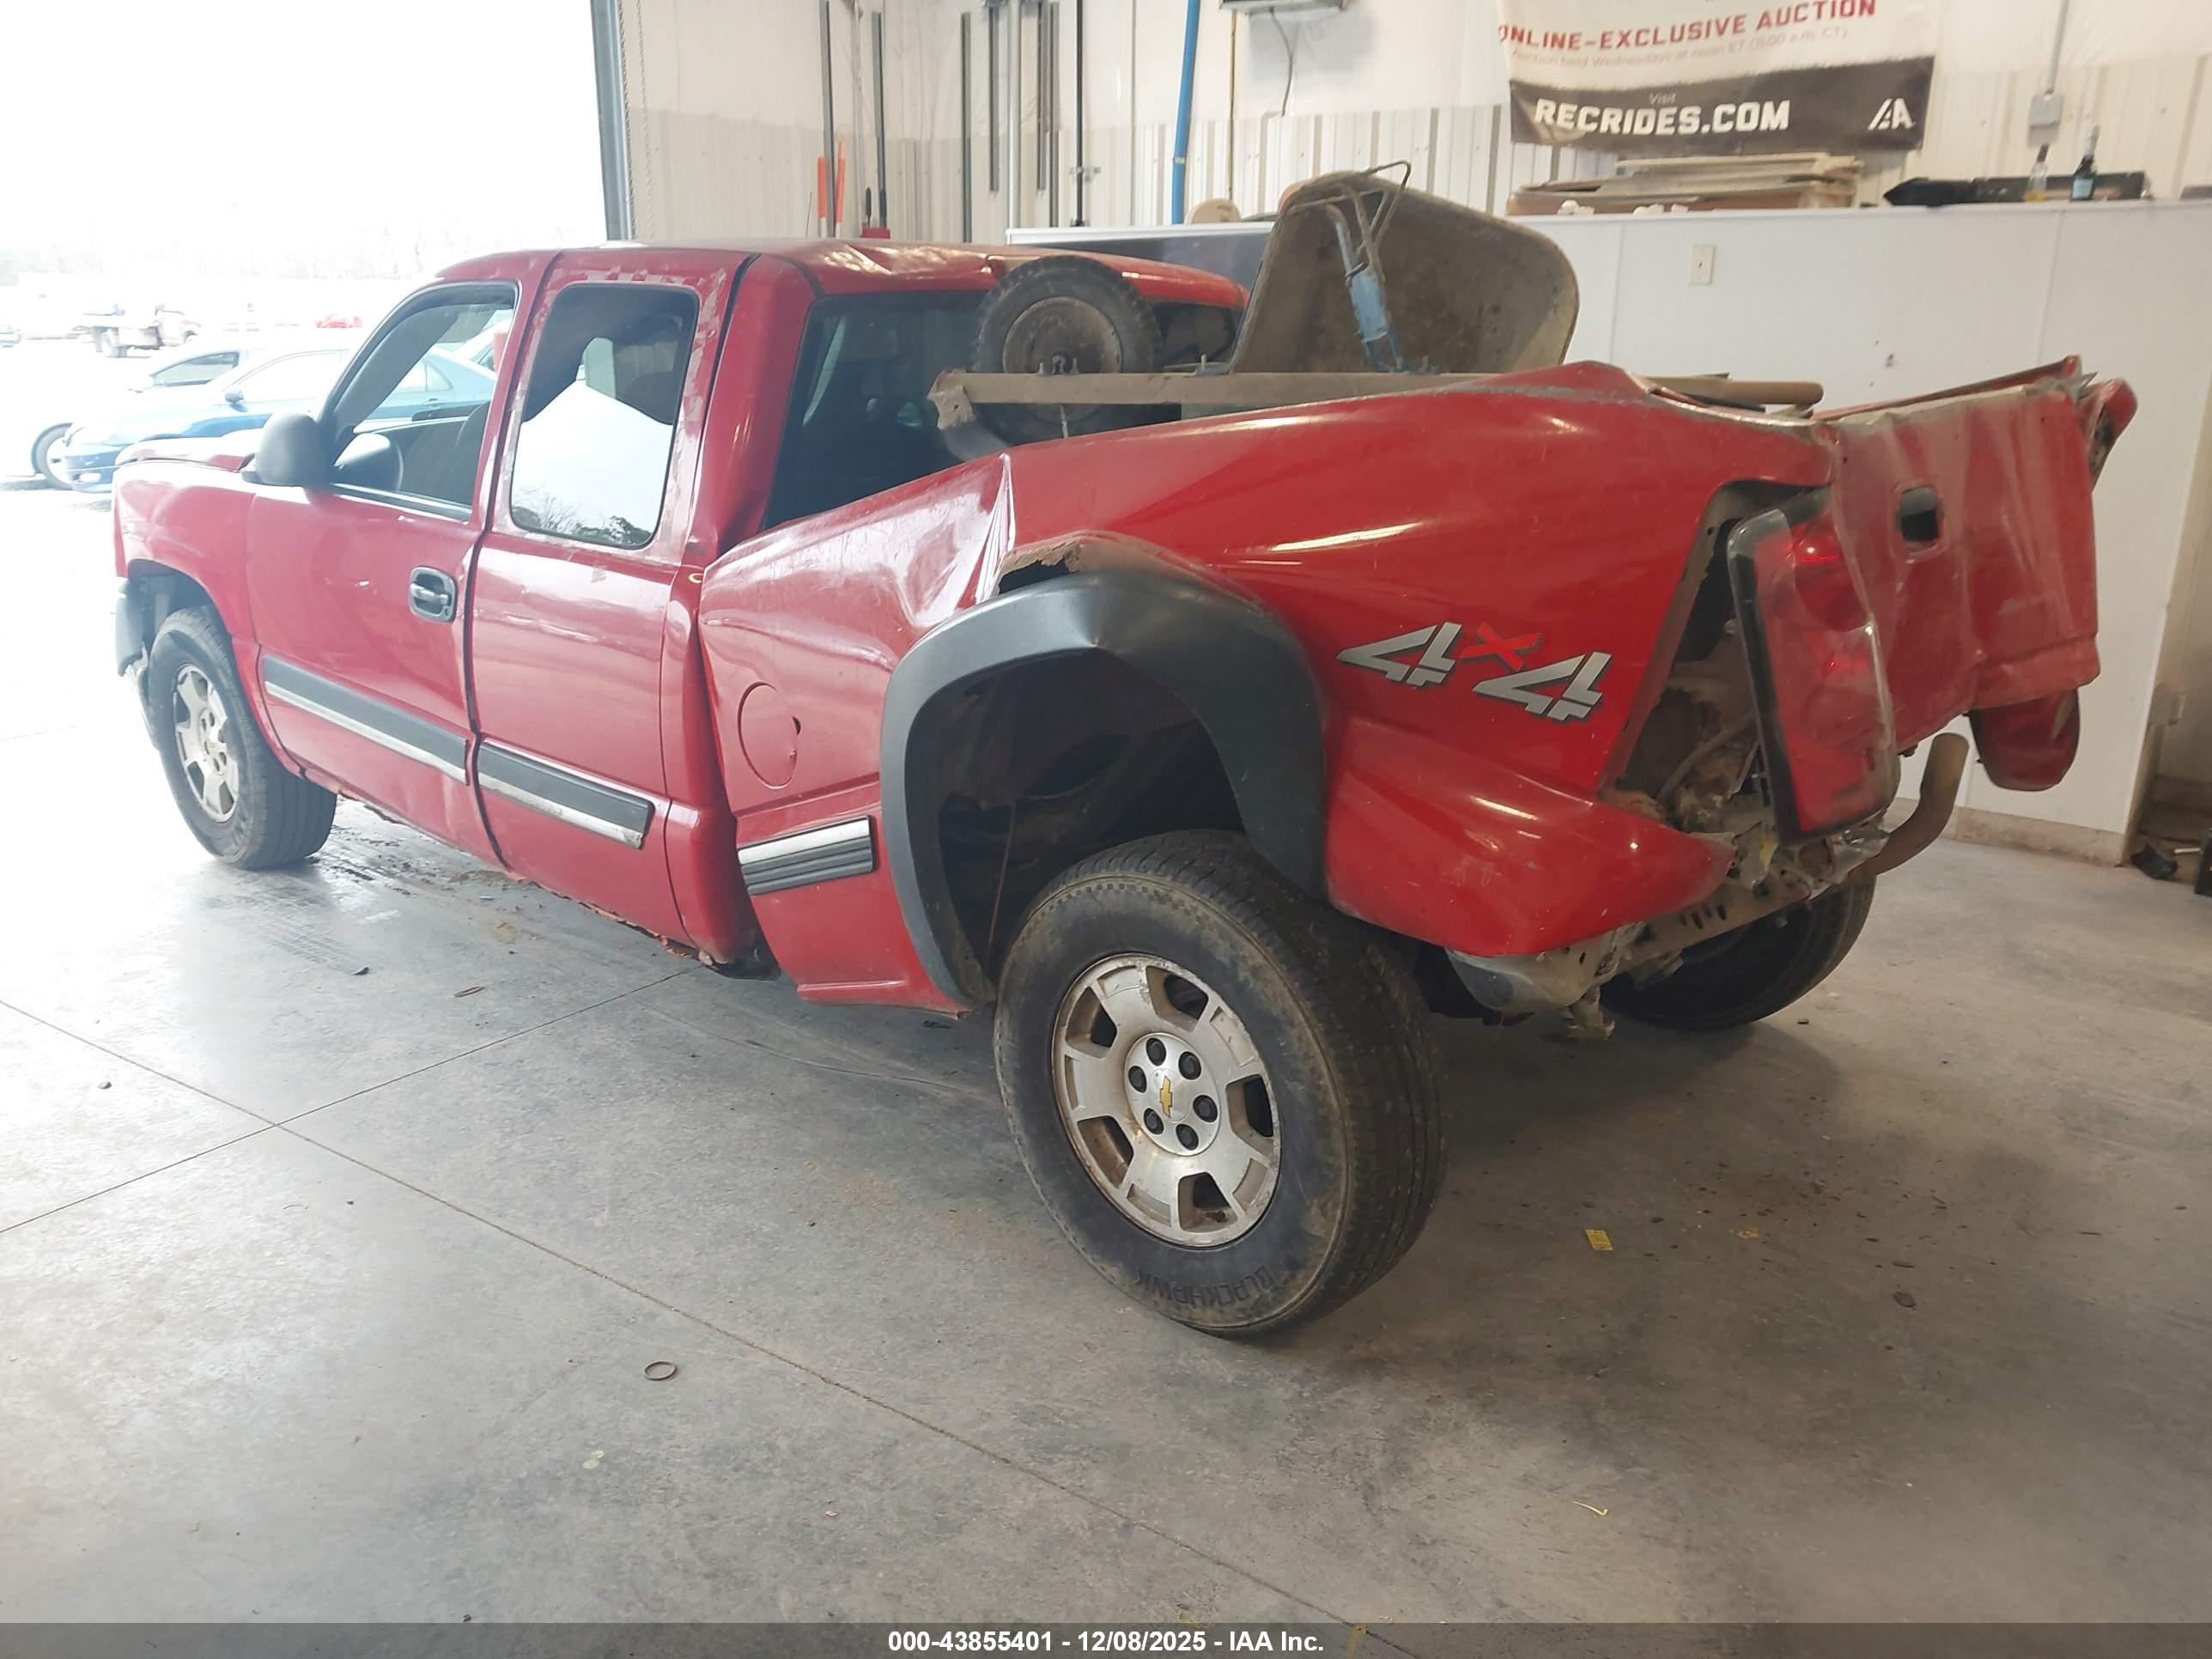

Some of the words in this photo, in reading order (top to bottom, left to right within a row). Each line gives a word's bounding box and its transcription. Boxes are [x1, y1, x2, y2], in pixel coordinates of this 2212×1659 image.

[1756, 0, 1876, 32] AUCTION
[1649, 92, 1677, 105] Visit
[1534, 98, 1791, 136] RECRIDES.COM
